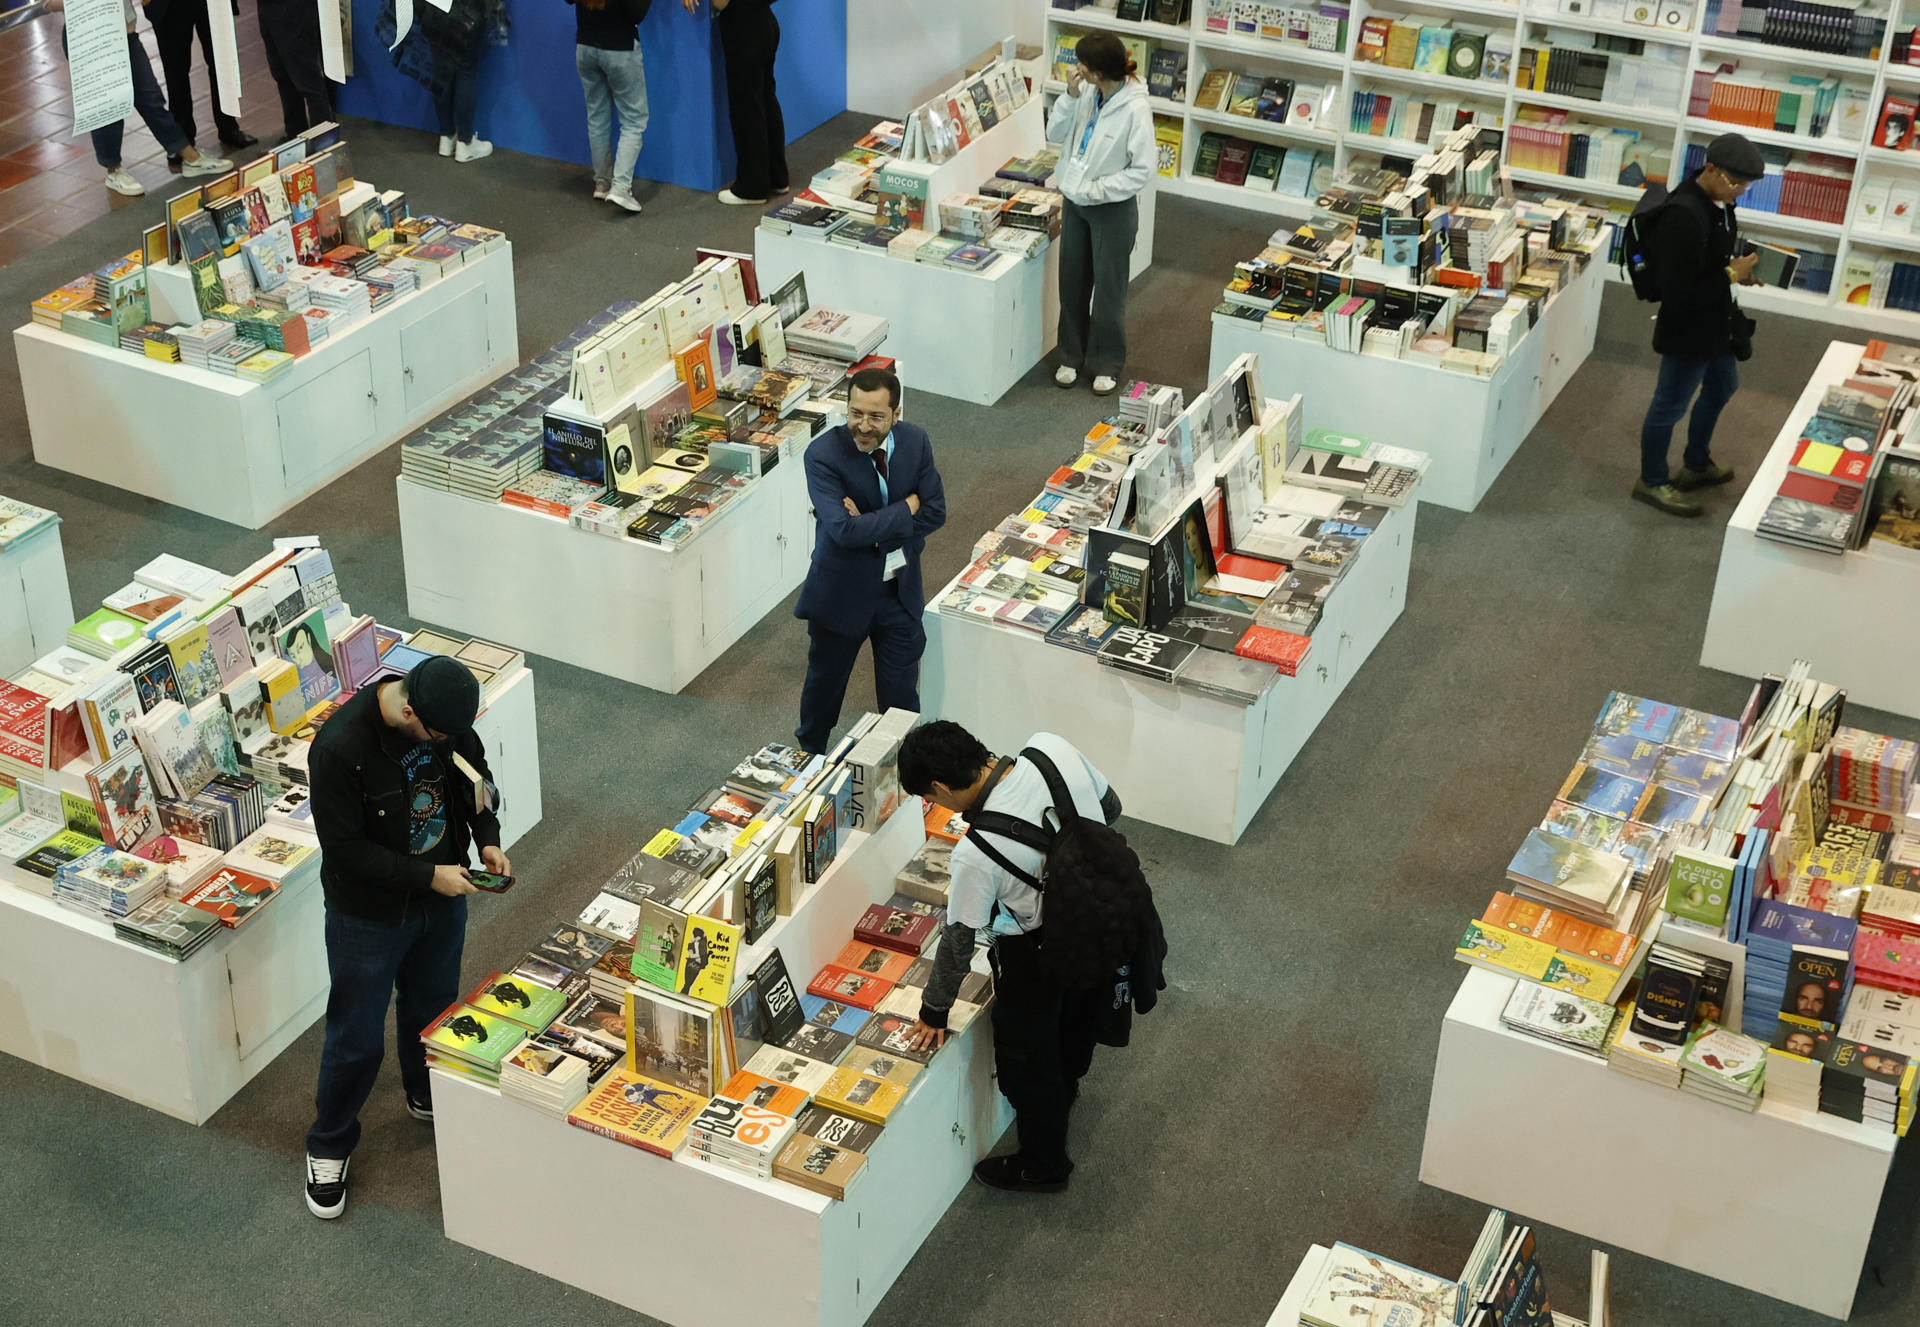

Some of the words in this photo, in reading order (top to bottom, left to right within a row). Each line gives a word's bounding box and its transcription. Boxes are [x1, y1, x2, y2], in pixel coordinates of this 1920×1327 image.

[886, 175, 919, 189] MOCOS
[547, 427, 557, 436] EL
[557, 429, 583, 442] ANILLO
[584, 436, 598, 446] DEL
[552, 433, 595, 450] NIBELUNGO
[1113, 625, 1145, 645] DA
[1124, 632, 1170, 664] CAPO
[134, 662, 151, 675] STAR
[3, 701, 18, 711] DE
[9, 696, 48, 717] VIDAS
[19, 719, 44, 736] OICOS
[28, 729, 44, 739] LOS
[12, 747, 30, 756] LOS
[1837, 735, 1858, 749] NO
[1863, 736, 1888, 761] ERES
[24, 750, 38, 758] DE
[846, 761, 864, 829] ELVIS
[67, 799, 96, 816] AUGUSTO
[63, 835, 94, 848] AUGUSTO
[119, 815, 151, 851] LOVE
[1820, 823, 1853, 851] 365
[1810, 847, 1823, 863] ARTE
[1831, 852, 1847, 875] SERVIR
[1845, 853, 1857, 872] PARA
[1676, 869, 1724, 890] KETO
[1678, 861, 1687, 870] LA
[1693, 866, 1726, 880] DIETA
[186, 876, 229, 907] MAZINGER
[717, 932, 730, 944] Kid
[708, 951, 730, 963] Powers
[1798, 961, 1837, 977] OPEN
[1647, 992, 1686, 1009] DISNEY
[1836, 1044, 1854, 1067] OPEN
[585, 1075, 630, 1116] JOHNNY
[600, 1097, 646, 1127] CASH
[629, 1121, 641, 1131] LA
[637, 1108, 655, 1123] VIDA
[646, 1112, 665, 1129] LETRAS
[658, 1120, 679, 1140] JOHNNY
[677, 1105, 691, 1121] CASH
[1503, 1264, 1536, 1327] Oceanarium
